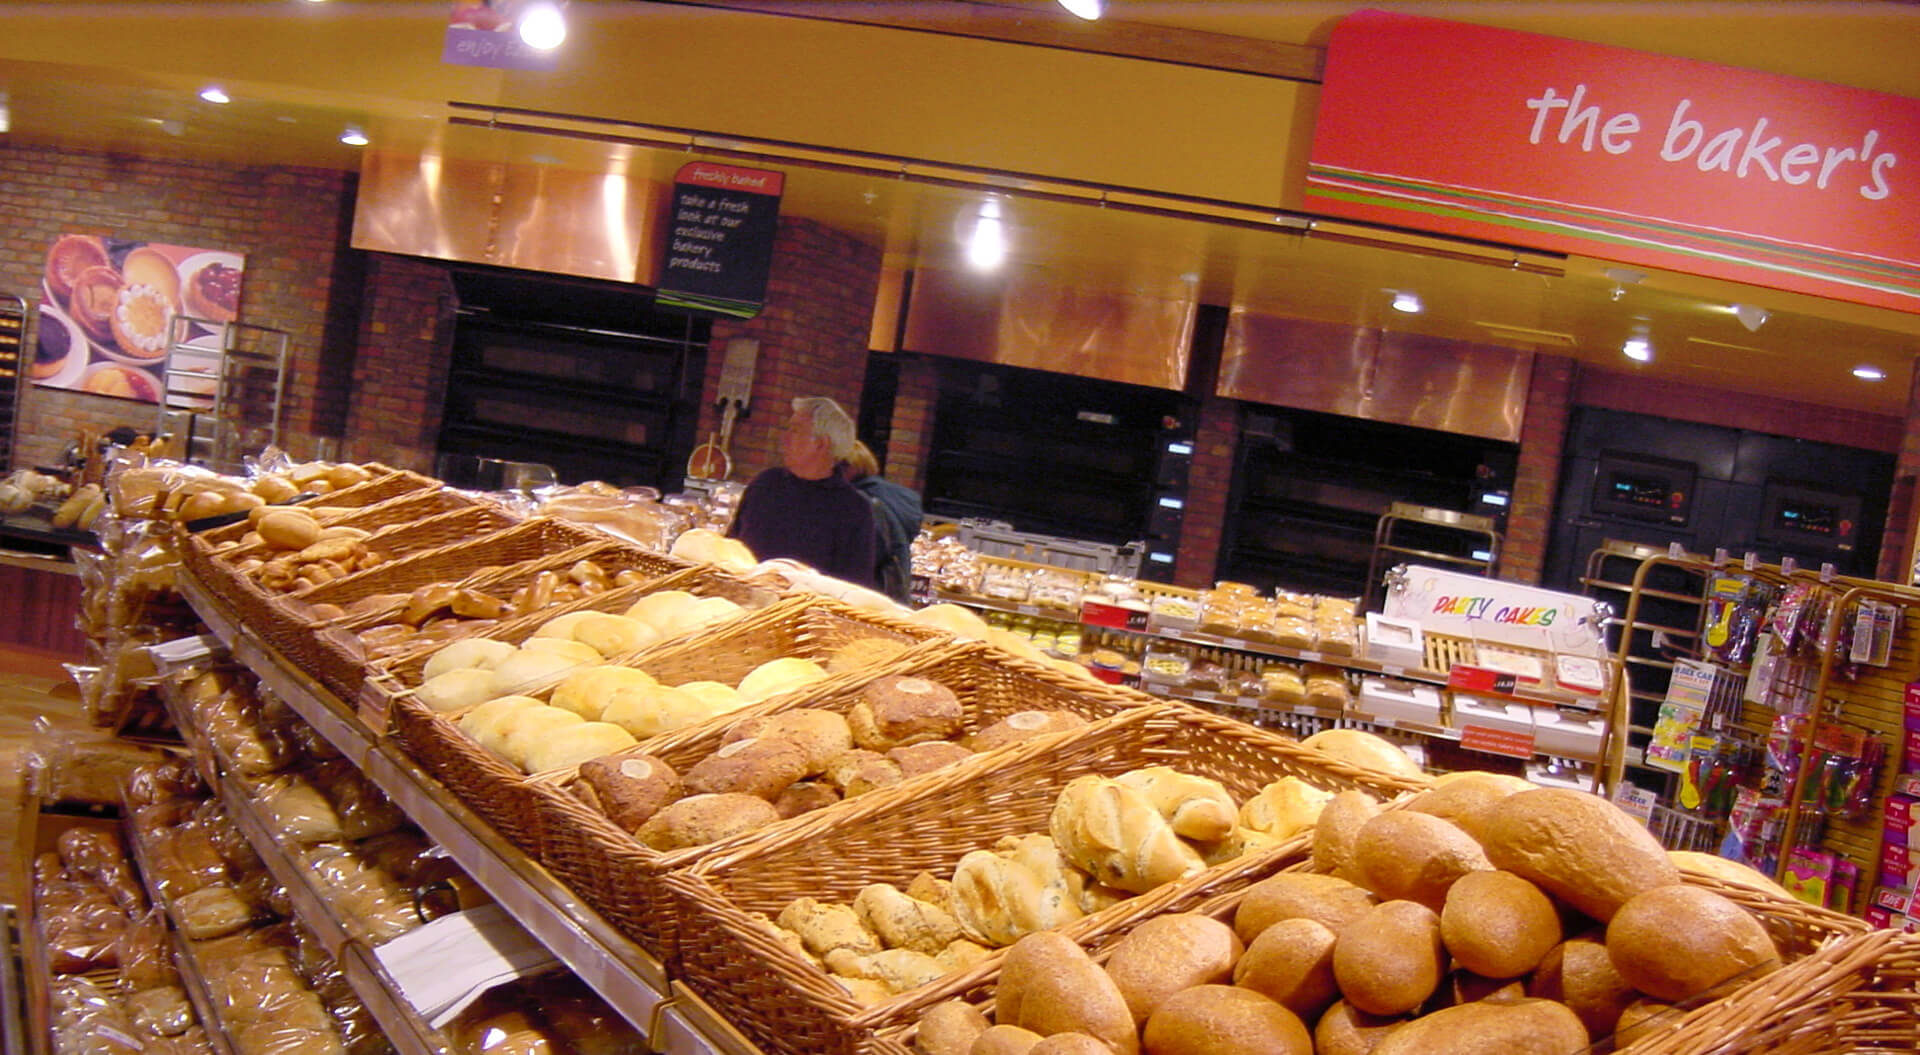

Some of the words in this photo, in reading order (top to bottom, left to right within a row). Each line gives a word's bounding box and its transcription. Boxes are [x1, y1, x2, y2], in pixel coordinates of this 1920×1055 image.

[1526, 84, 1640, 154] the
[1660, 99, 1896, 200] baker's
[693, 167, 729, 186] freshly
[731, 173, 766, 188] baked
[680, 194, 705, 207] take
[707, 200, 717, 209] a
[718, 198, 749, 213] fresh
[677, 208, 701, 222] look
[704, 213, 719, 225] at
[720, 217, 743, 229] our
[674, 227, 726, 242] exclusive
[672, 239, 712, 258] bakery
[669, 257, 721, 272] products
[1432, 596, 1494, 620] PARTY
[1494, 607, 1557, 627] CAKES
